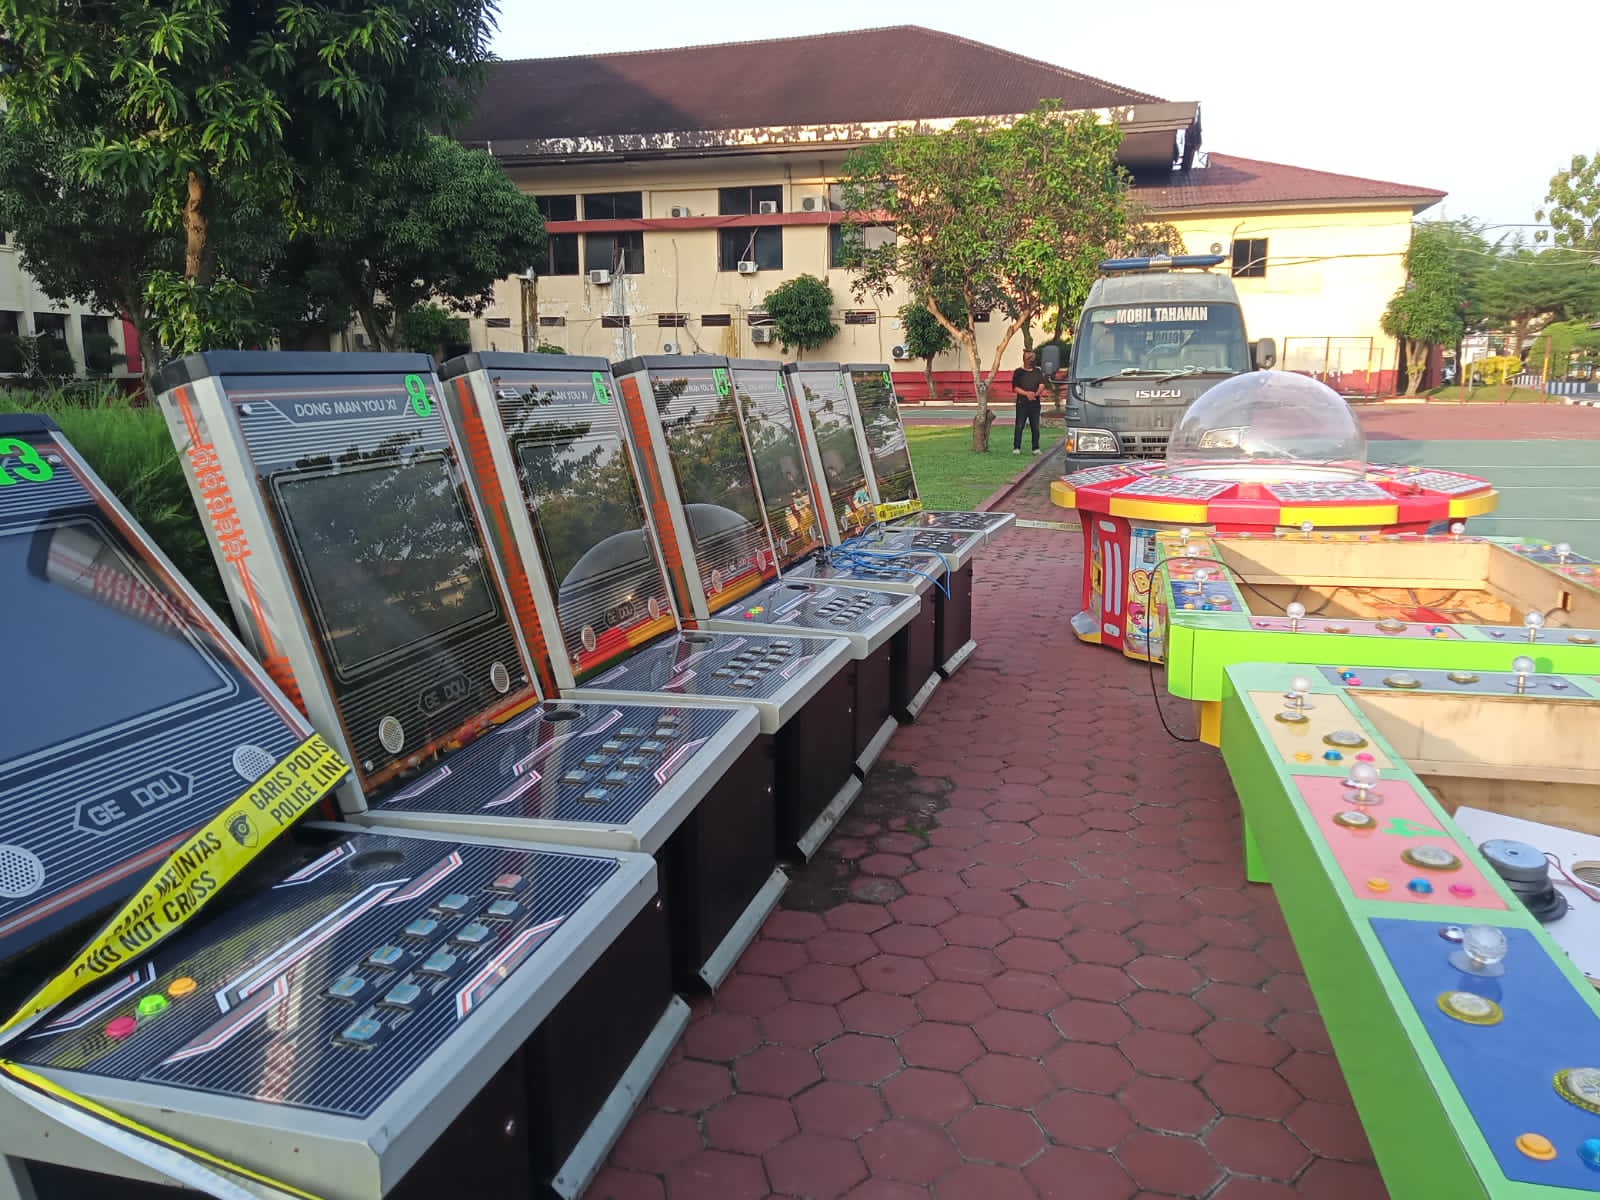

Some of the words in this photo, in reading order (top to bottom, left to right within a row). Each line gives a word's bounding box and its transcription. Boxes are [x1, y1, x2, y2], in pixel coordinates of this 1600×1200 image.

[1116, 308, 1153, 324] MOBIL
[1154, 306, 1208, 322] TAHANAN
[405, 374, 432, 417] 8
[591, 371, 609, 406] 6
[712, 368, 729, 396] 15
[1136, 389, 1181, 398] ISUZU
[294, 402, 332, 417] DONG
[333, 400, 361, 414] MAN
[361, 398, 385, 412] YOU
[386, 398, 398, 411] XI
[249, 771, 292, 810] GARIS
[286, 738, 331, 777] POLIS
[270, 781, 318, 825] POLICE
[311, 754, 347, 787] LINE
[88, 799, 127, 826] GE
[131, 775, 182, 808] DOU
[119, 912, 161, 951] NOT
[162, 870, 216, 922] CROSS
